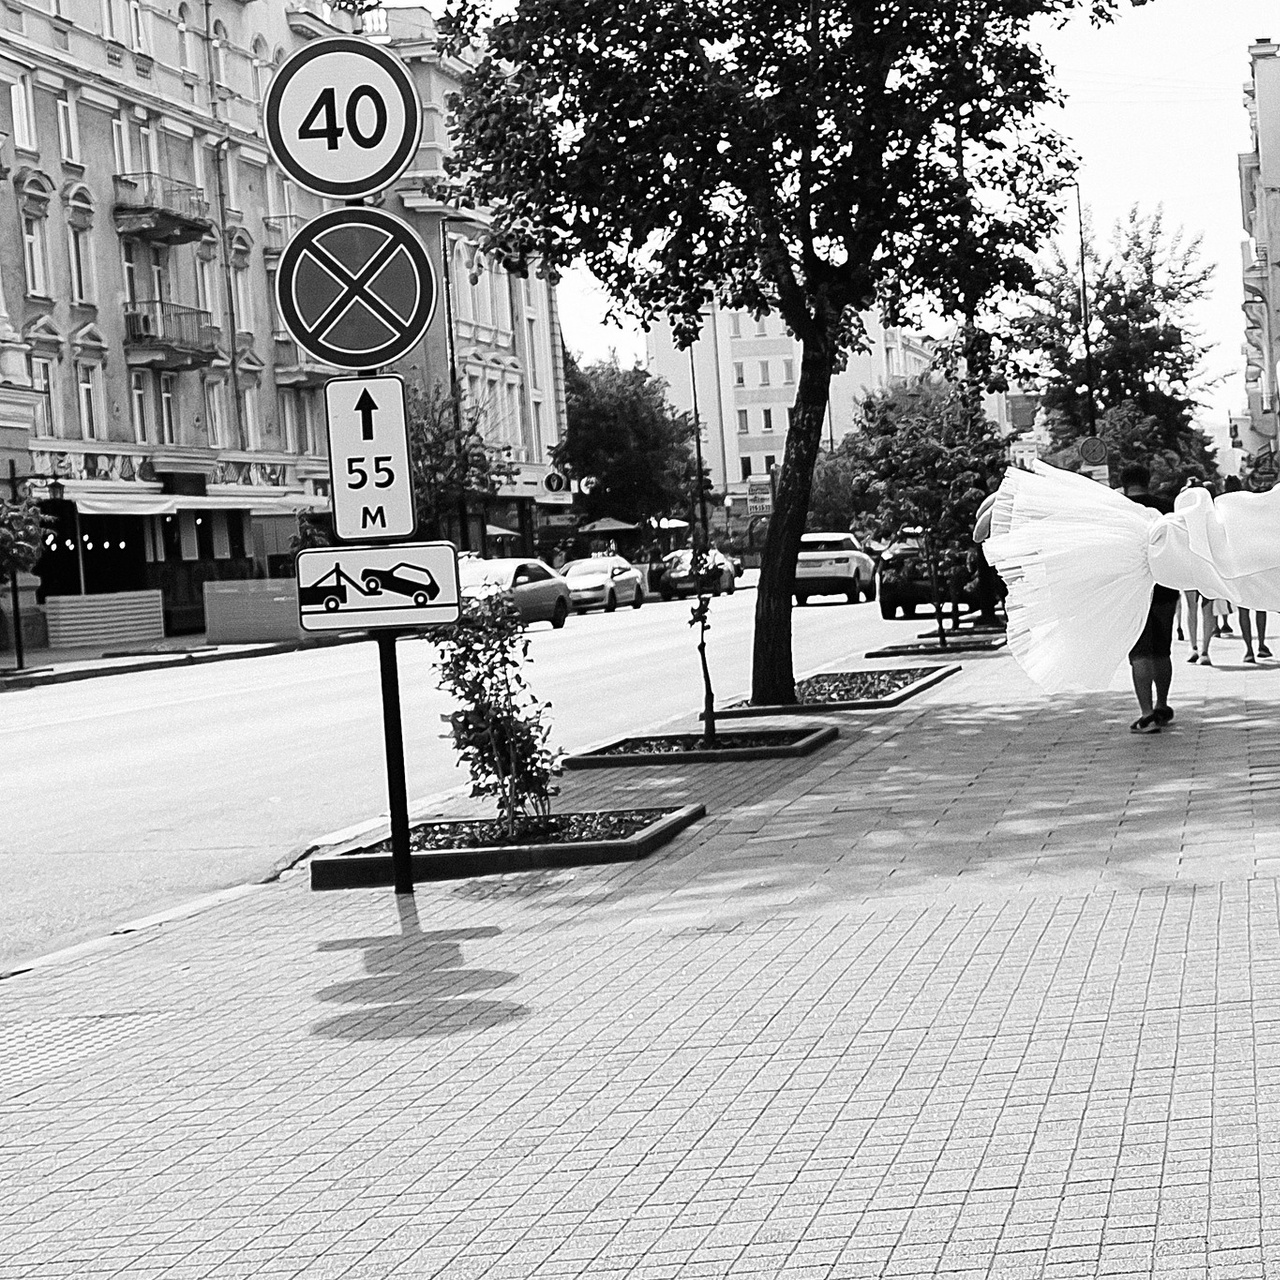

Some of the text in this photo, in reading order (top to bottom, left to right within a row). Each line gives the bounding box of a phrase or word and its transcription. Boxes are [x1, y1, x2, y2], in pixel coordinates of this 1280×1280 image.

[298, 84, 388, 150] 40
[346, 456, 395, 489] 55
[361, 506, 387, 528] М
